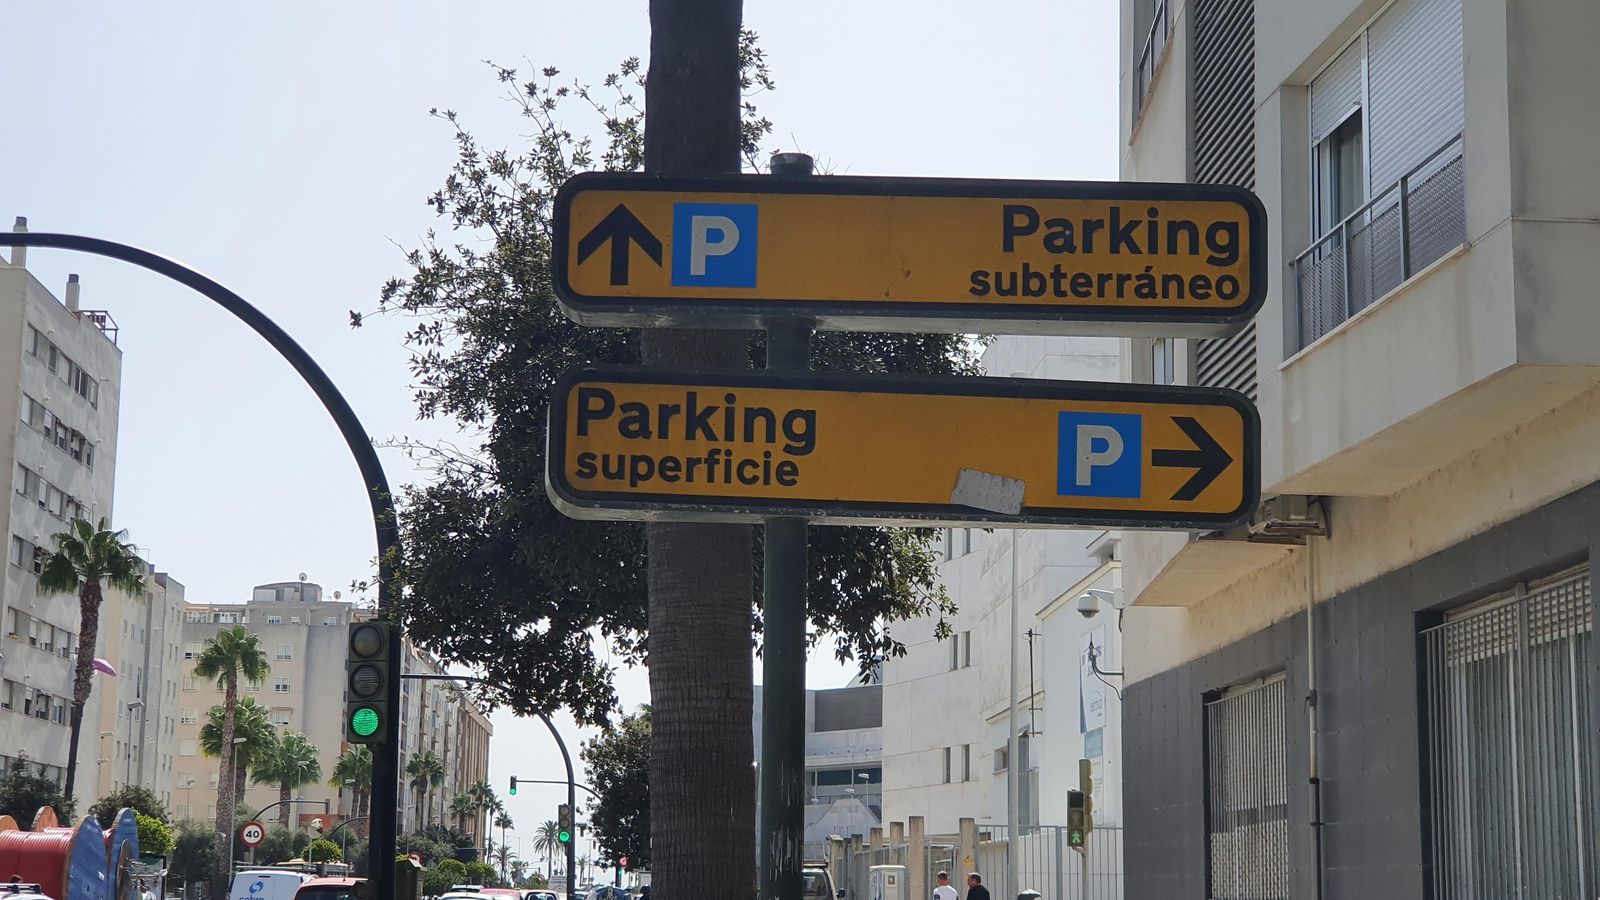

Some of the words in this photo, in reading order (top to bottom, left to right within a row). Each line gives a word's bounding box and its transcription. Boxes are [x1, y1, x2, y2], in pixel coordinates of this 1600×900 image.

[690, 215, 740, 276] P
[1003, 204, 1239, 267] Parking
[968, 262, 1241, 301] subterráneo
[576, 386, 817, 456] Parking
[575, 448, 799, 488] superficie
[1076, 424, 1124, 486] P
[245, 830, 260, 838] 40
